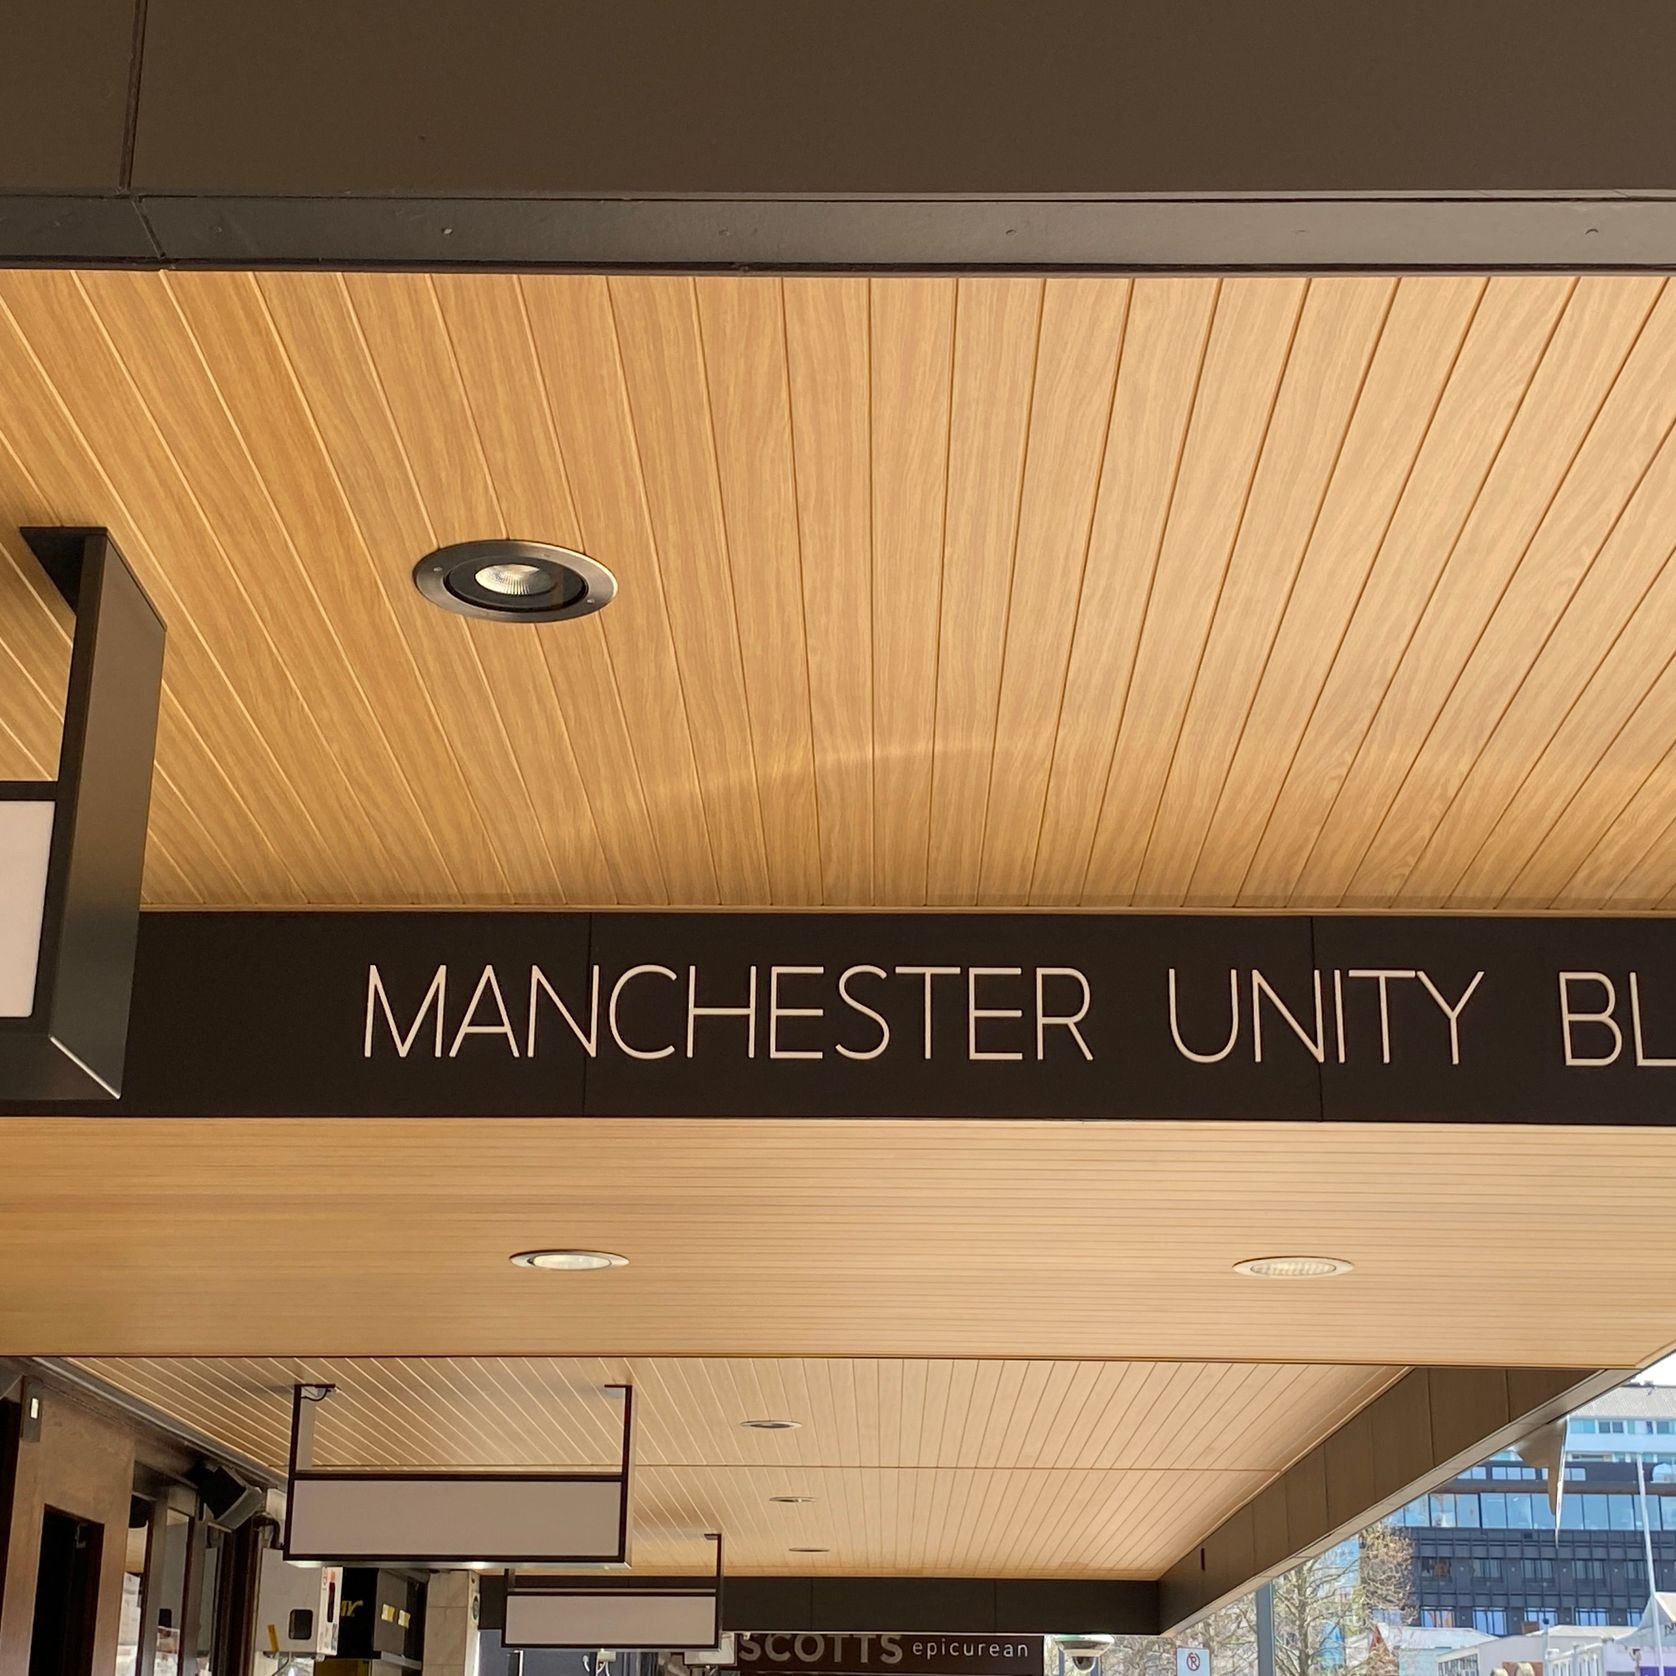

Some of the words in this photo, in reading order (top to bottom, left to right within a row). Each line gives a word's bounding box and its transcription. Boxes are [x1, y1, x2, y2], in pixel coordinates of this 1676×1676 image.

[364, 964, 1095, 1062] MANCHESTER
[1167, 968, 1485, 1066] UNITY
[1558, 971, 1676, 1068] BL
[739, 1633, 903, 1664] SCOTTS
[912, 1638, 1029, 1660] epicurean
